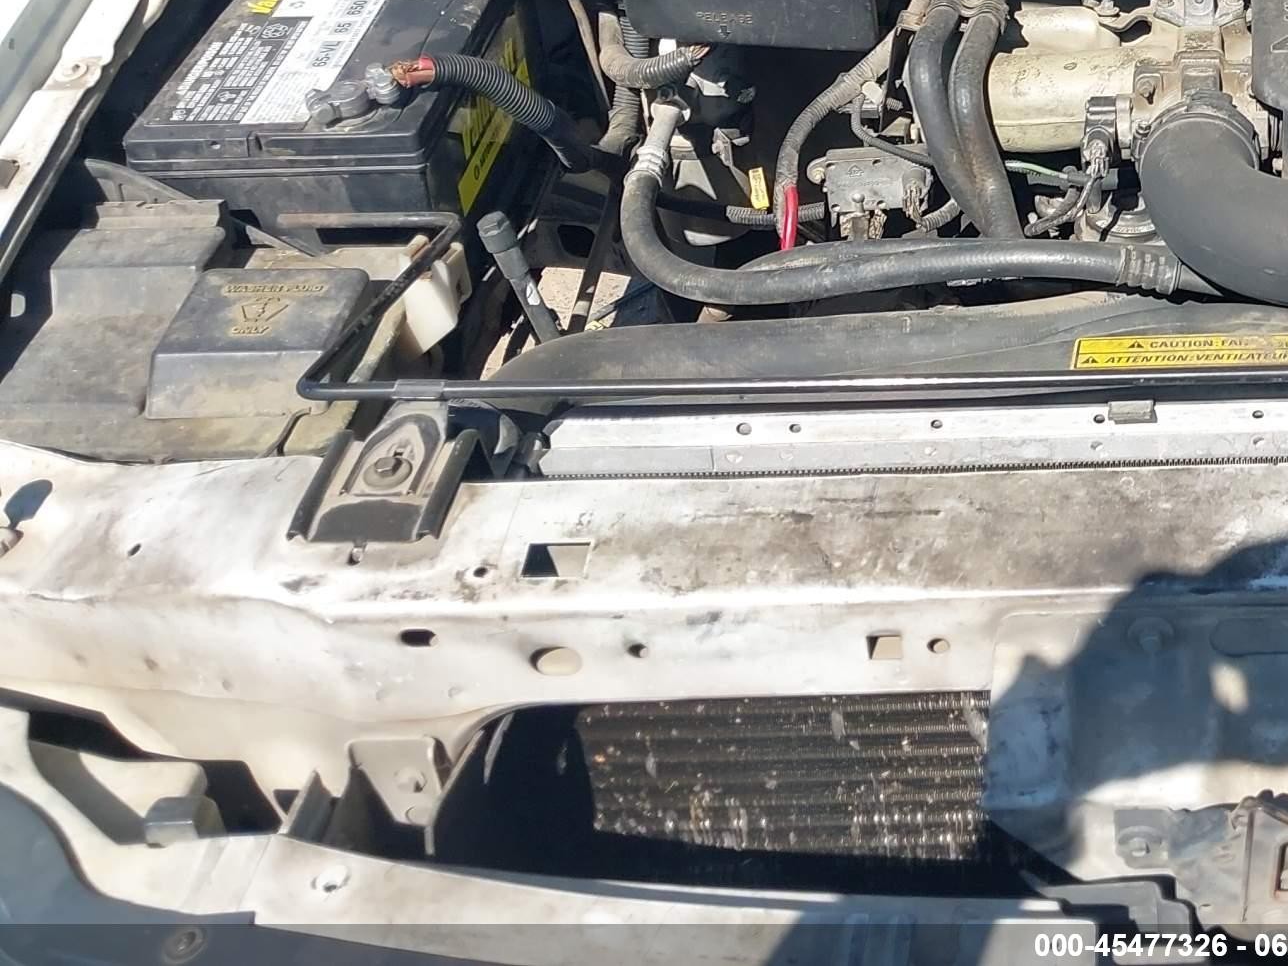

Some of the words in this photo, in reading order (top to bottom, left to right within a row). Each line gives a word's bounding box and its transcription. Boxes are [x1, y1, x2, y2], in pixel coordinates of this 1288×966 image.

[346, 0, 369, 16] 650
[334, 22, 353, 35] 65
[311, 40, 341, 68] 65-VL
[230, 325, 271, 335] ONLY
